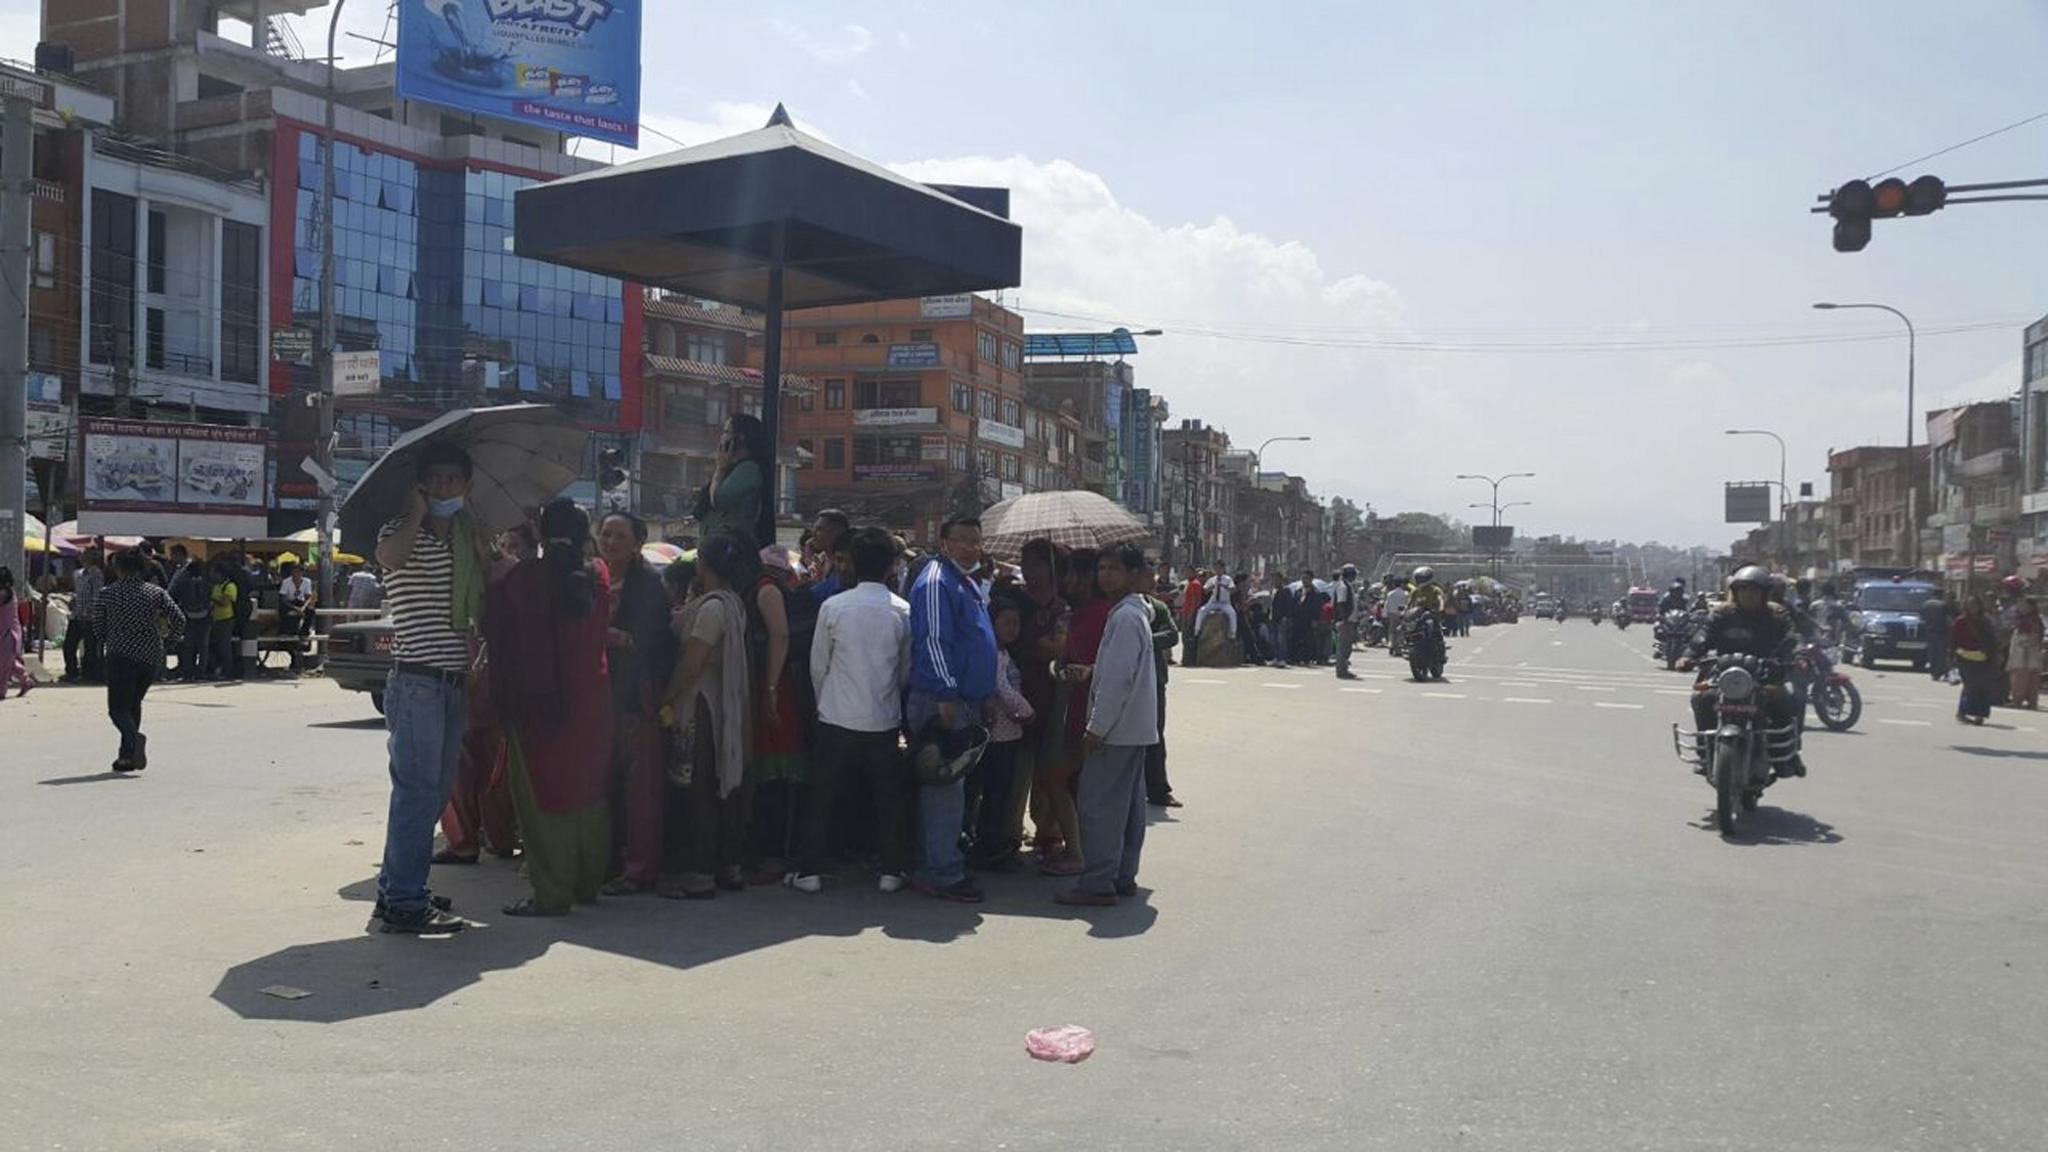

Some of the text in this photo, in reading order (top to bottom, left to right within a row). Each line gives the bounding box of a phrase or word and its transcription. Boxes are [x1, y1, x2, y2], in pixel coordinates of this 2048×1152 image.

[523, 103, 541, 114] the
[544, 107, 572, 121] taste
[574, 114, 595, 126] that
